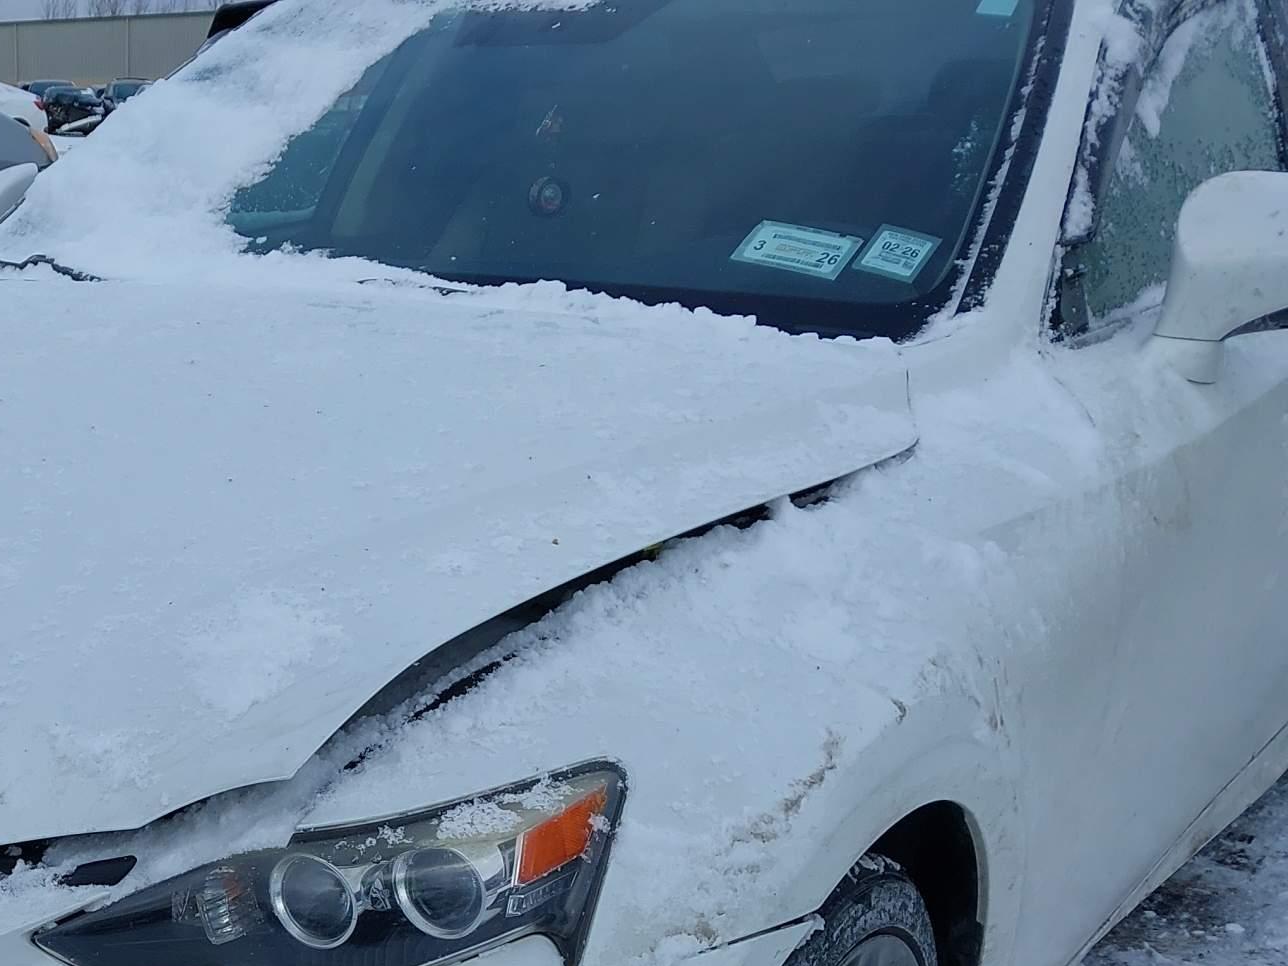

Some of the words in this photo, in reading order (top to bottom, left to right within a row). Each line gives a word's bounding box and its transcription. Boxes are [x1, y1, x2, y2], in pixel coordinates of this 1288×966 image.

[753, 239, 767, 251] 3
[881, 240, 901, 253] 02
[901, 246, 921, 259] 26
[815, 251, 841, 266] 26
